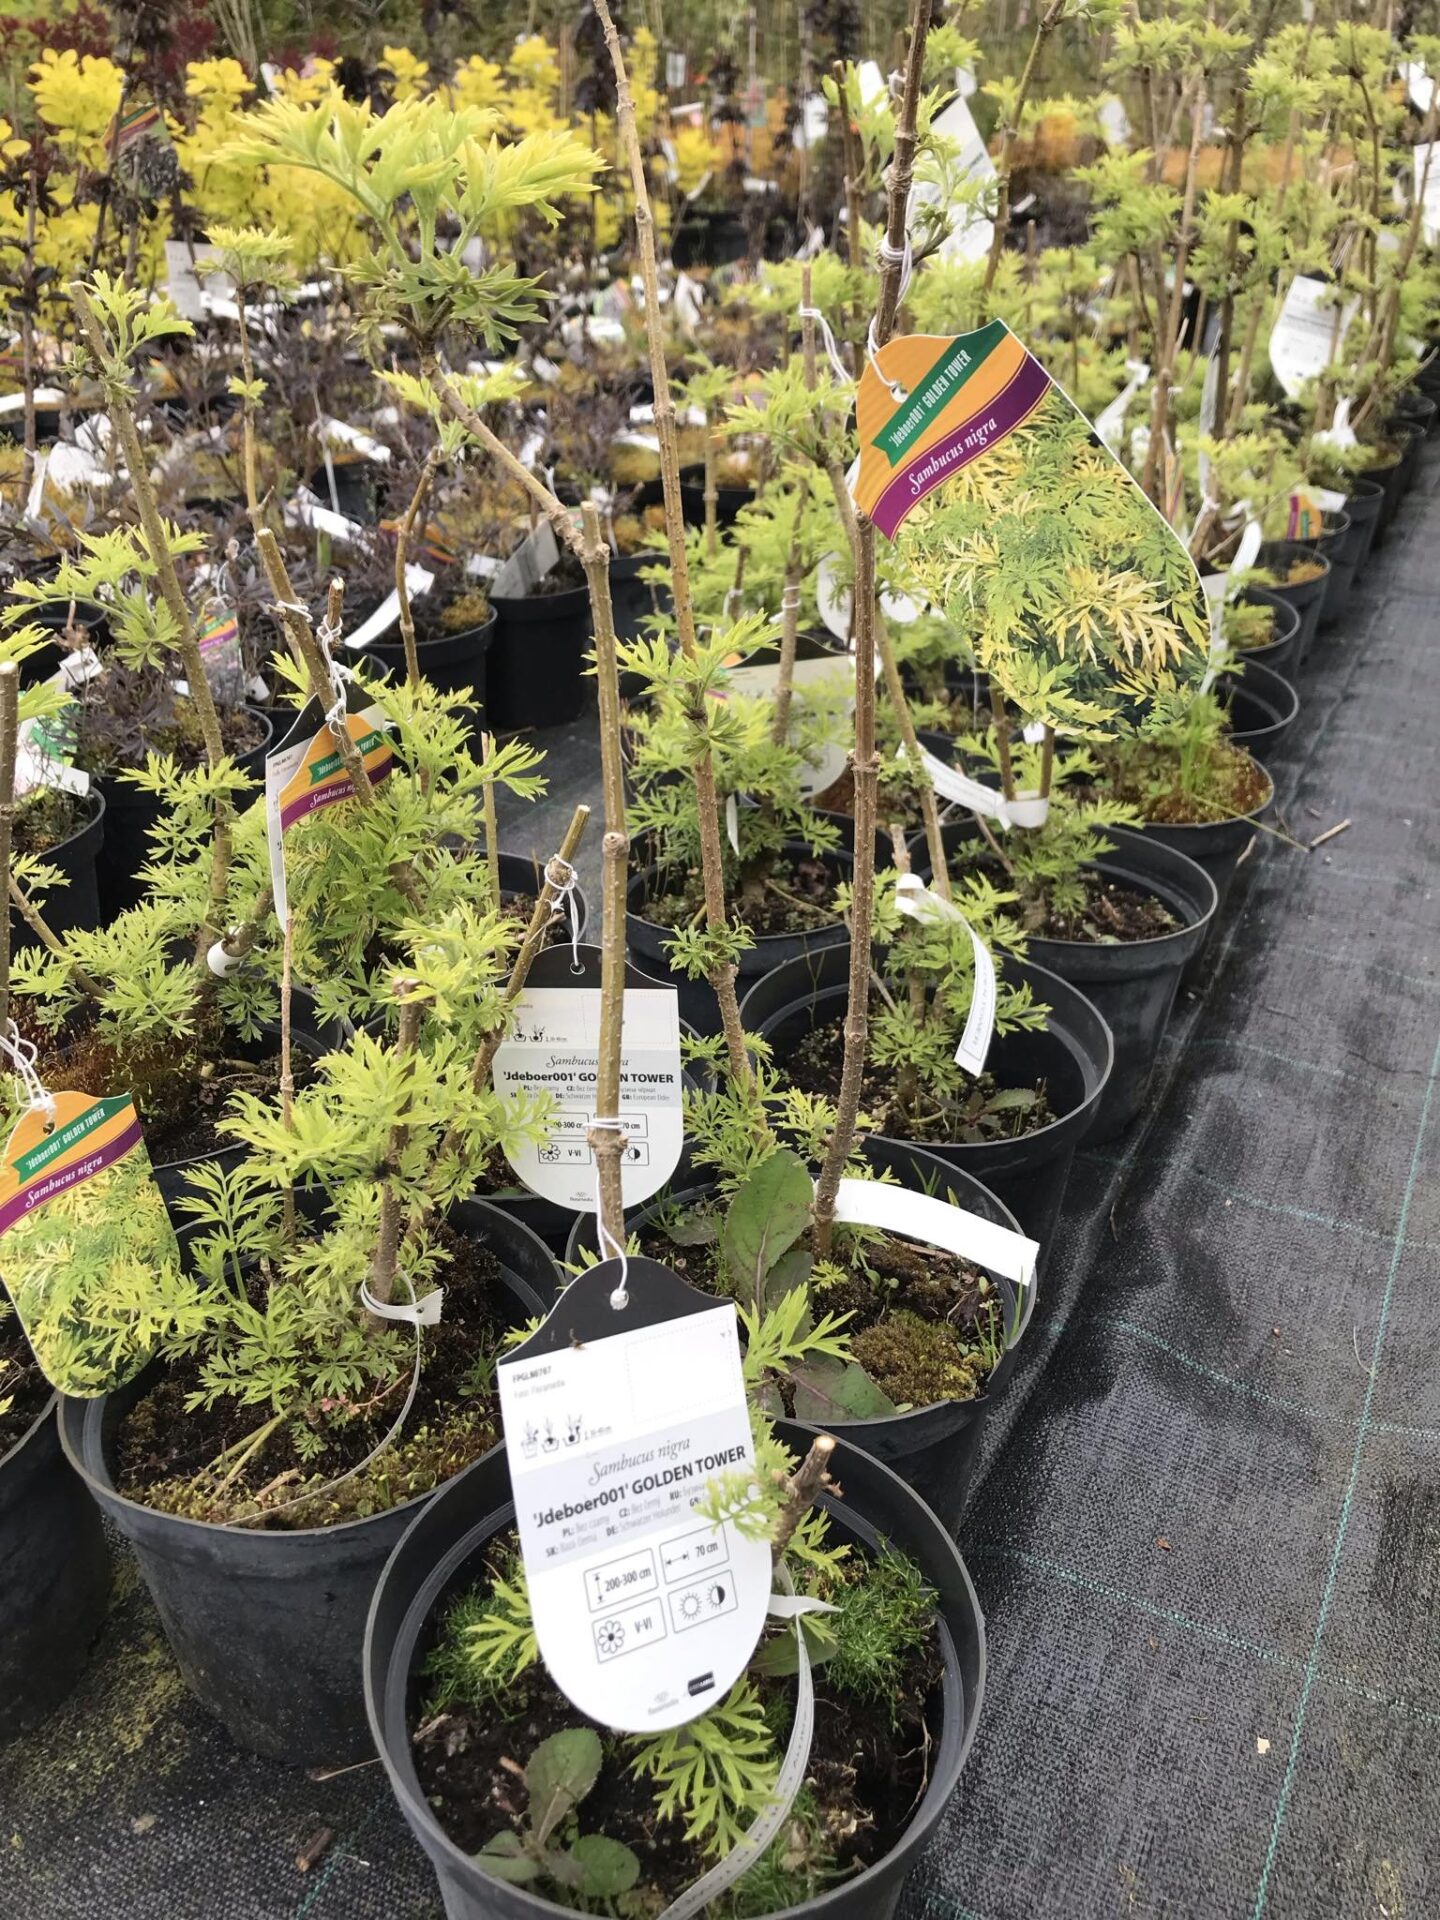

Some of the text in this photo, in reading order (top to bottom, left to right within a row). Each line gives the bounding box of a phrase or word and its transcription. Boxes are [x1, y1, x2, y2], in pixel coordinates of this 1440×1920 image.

[922, 375, 950, 408] GOLDEN
[944, 349, 972, 381] TOWER
[909, 417, 997, 494] Sambucus nigra
[310, 786, 346, 808] Sambucus
[545, 1055, 598, 1068] Sambucus
[503, 1071, 674, 1084] 'Jdeboer001' GON TOWER
[62, 1122, 85, 1144] GOLDEN
[85, 1108, 105, 1128] TOWER
[568, 1149, 581, 1157] V-VI
[25, 1156, 103, 1208] Sambucus nigra
[587, 1437, 690, 1486] Sambucus nigra
[533, 1445, 746, 1528] 'Jdeboer001' GOLDEN TOWER
[695, 1542, 718, 1557] 70 cm
[605, 1568, 652, 1592] 200-300 cm
[634, 1617, 652, 1634] V-VI
